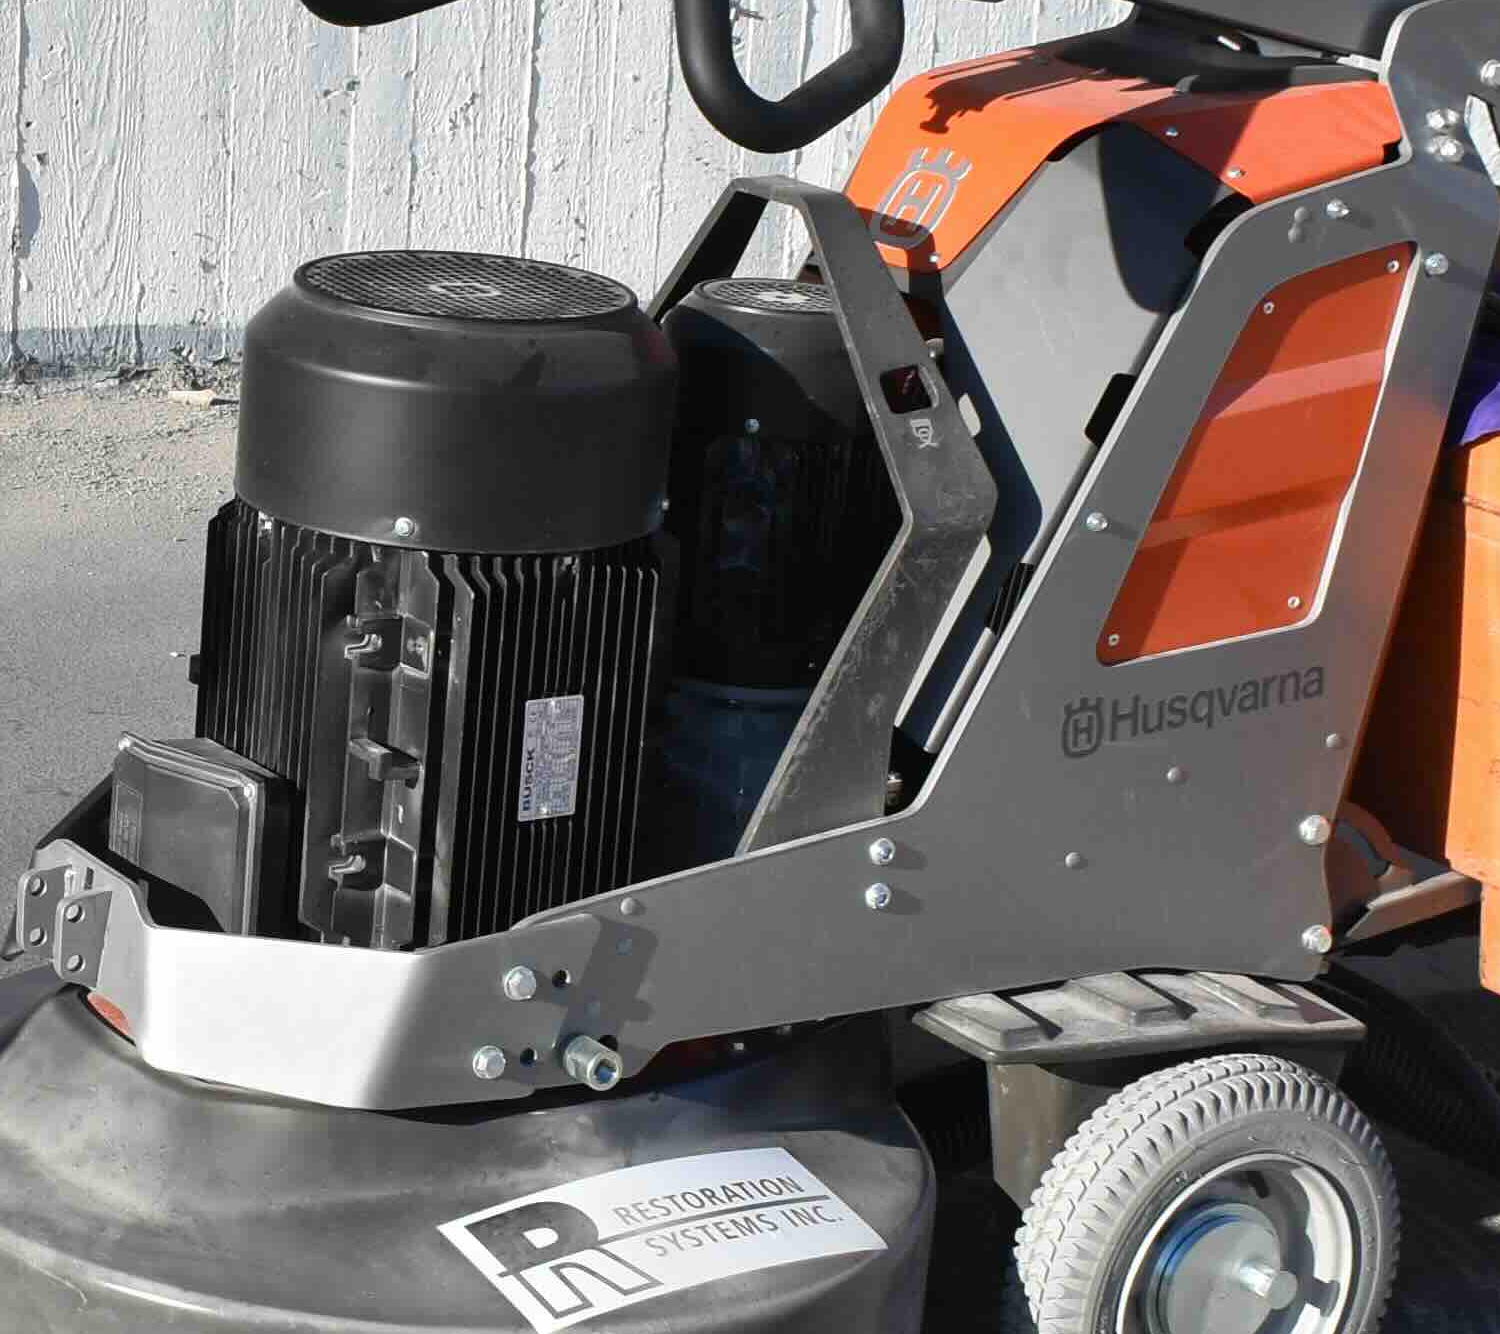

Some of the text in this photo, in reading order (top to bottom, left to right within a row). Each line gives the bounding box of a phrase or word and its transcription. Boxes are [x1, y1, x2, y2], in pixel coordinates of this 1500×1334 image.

[1109, 666, 1325, 741] Husqvarna
[612, 1175, 805, 1226] RESTORATION
[643, 1203, 841, 1257] SYSTEMS INC.
